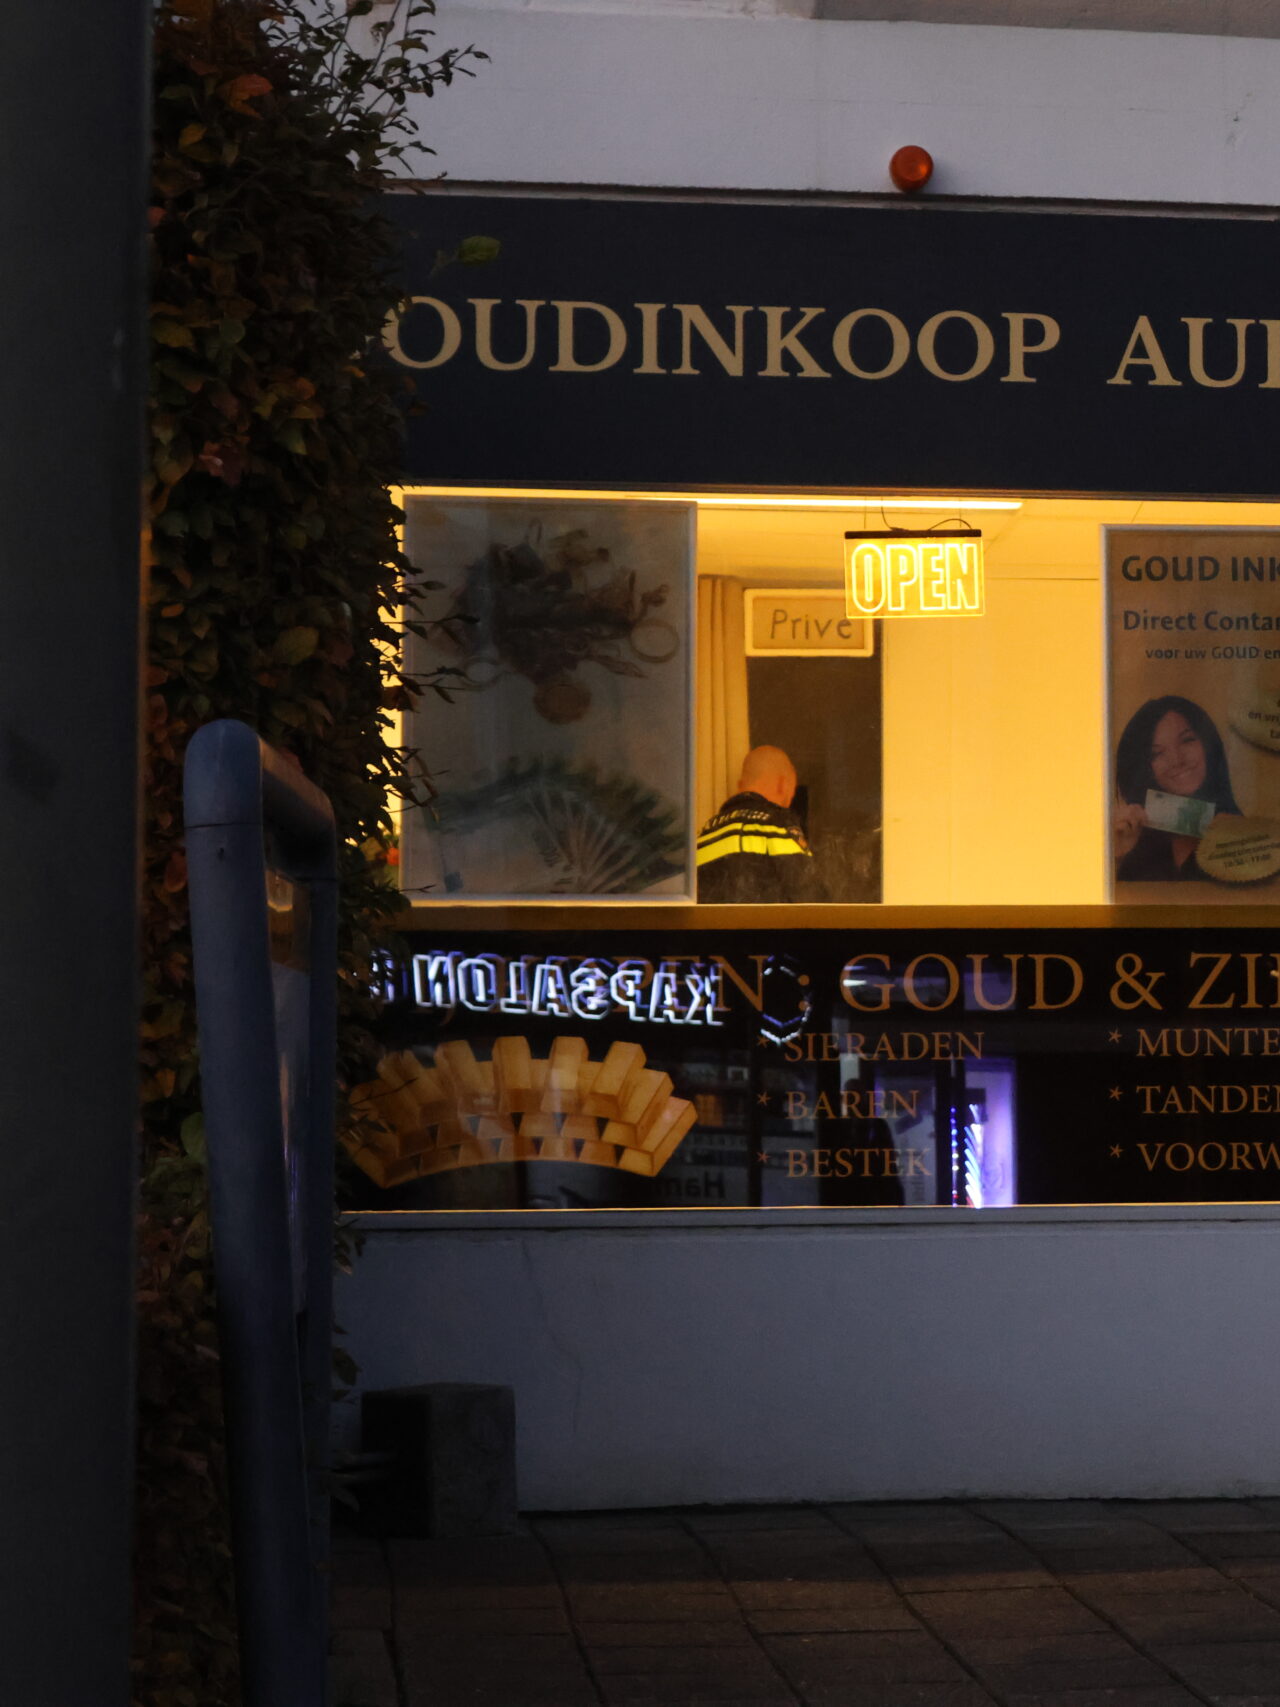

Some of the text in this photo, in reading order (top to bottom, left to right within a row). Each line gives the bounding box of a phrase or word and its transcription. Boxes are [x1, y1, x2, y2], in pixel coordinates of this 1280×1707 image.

[380, 295, 1061, 383] OUDINKOOP
[851, 542, 980, 614] OPEN
[1121, 555, 1220, 582] GOUD
[1123, 609, 1196, 631] Direct
[1145, 649, 1179, 660] voor
[1184, 649, 1206, 660] uw
[1211, 646, 1259, 660] GOUD
[1247, 711, 1262, 720] en
[840, 953, 1084, 1012] GOUD
[1109, 953, 1166, 1011] &
[784, 1031, 984, 1062] SIERADEN
[785, 1090, 919, 1120] BAREN
[785, 1149, 932, 1178] BESTEK
